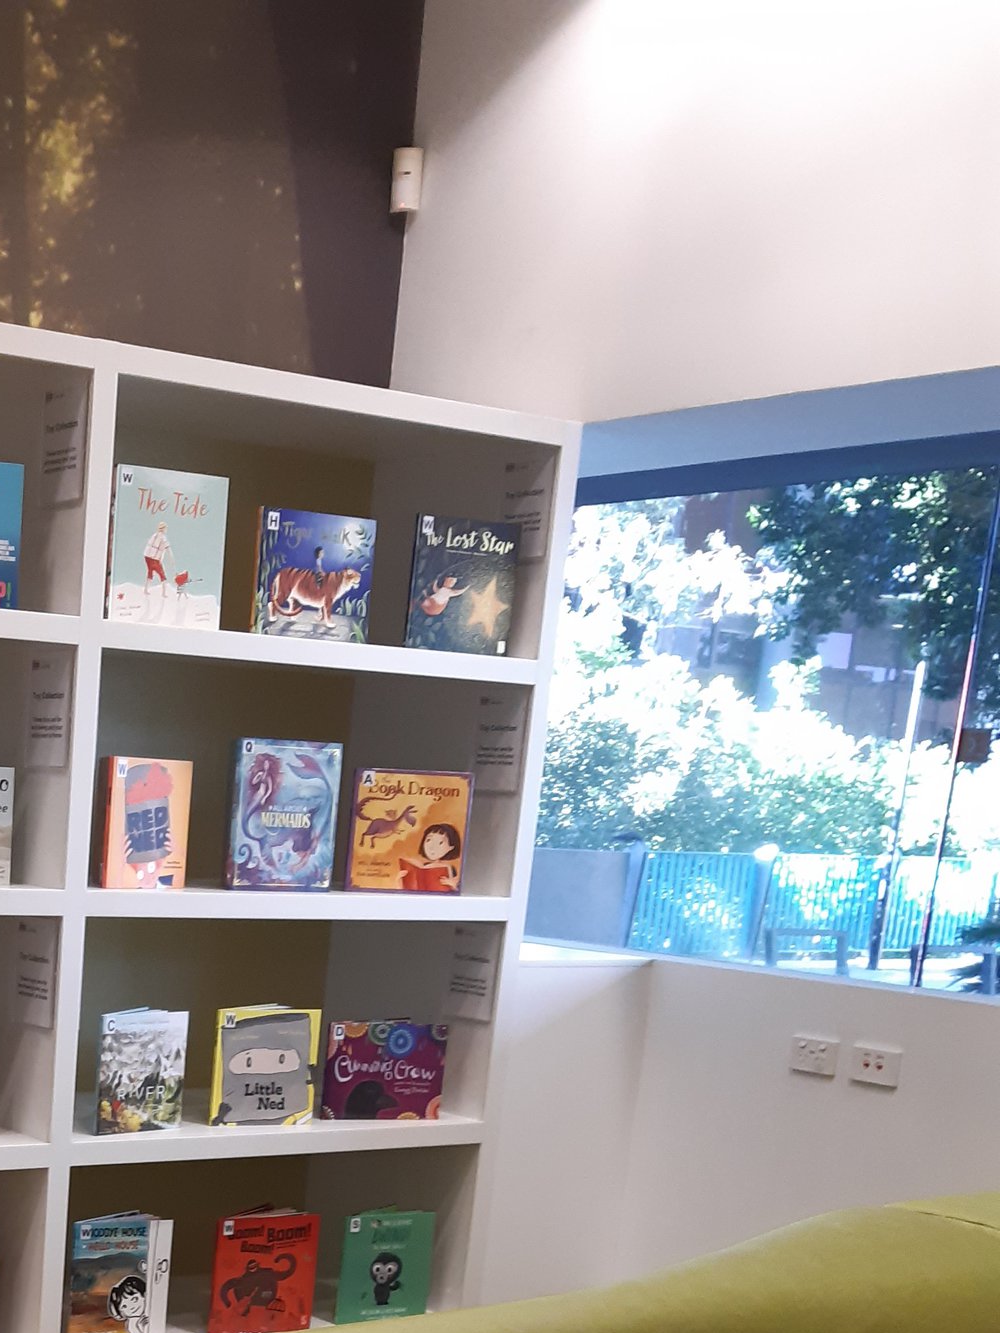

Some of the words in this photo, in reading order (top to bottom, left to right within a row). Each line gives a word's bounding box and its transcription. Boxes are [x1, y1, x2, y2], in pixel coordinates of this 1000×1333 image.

[122, 473, 133, 483] W
[138, 487, 169, 516] The
[173, 491, 210, 519] Tide
[269, 514, 279, 528] H
[427, 531, 444, 546] The
[446, 526, 478, 549] Lost
[480, 530, 515, 556] Star
[118, 763, 127, 776] W
[363, 774, 373, 784] A
[407, 781, 460, 801] Dragon
[261, 811, 311, 829] MERMAIDS
[107, 1019, 116, 1032] C
[225, 1014, 236, 1026] W
[335, 1026, 344, 1037] D
[117, 1084, 166, 1101] RIVER
[244, 1081, 283, 1097] Little
[256, 1097, 286, 1111] Ned
[352, 1219, 360, 1229] S
[120, 1226, 147, 1237] HOUSE
